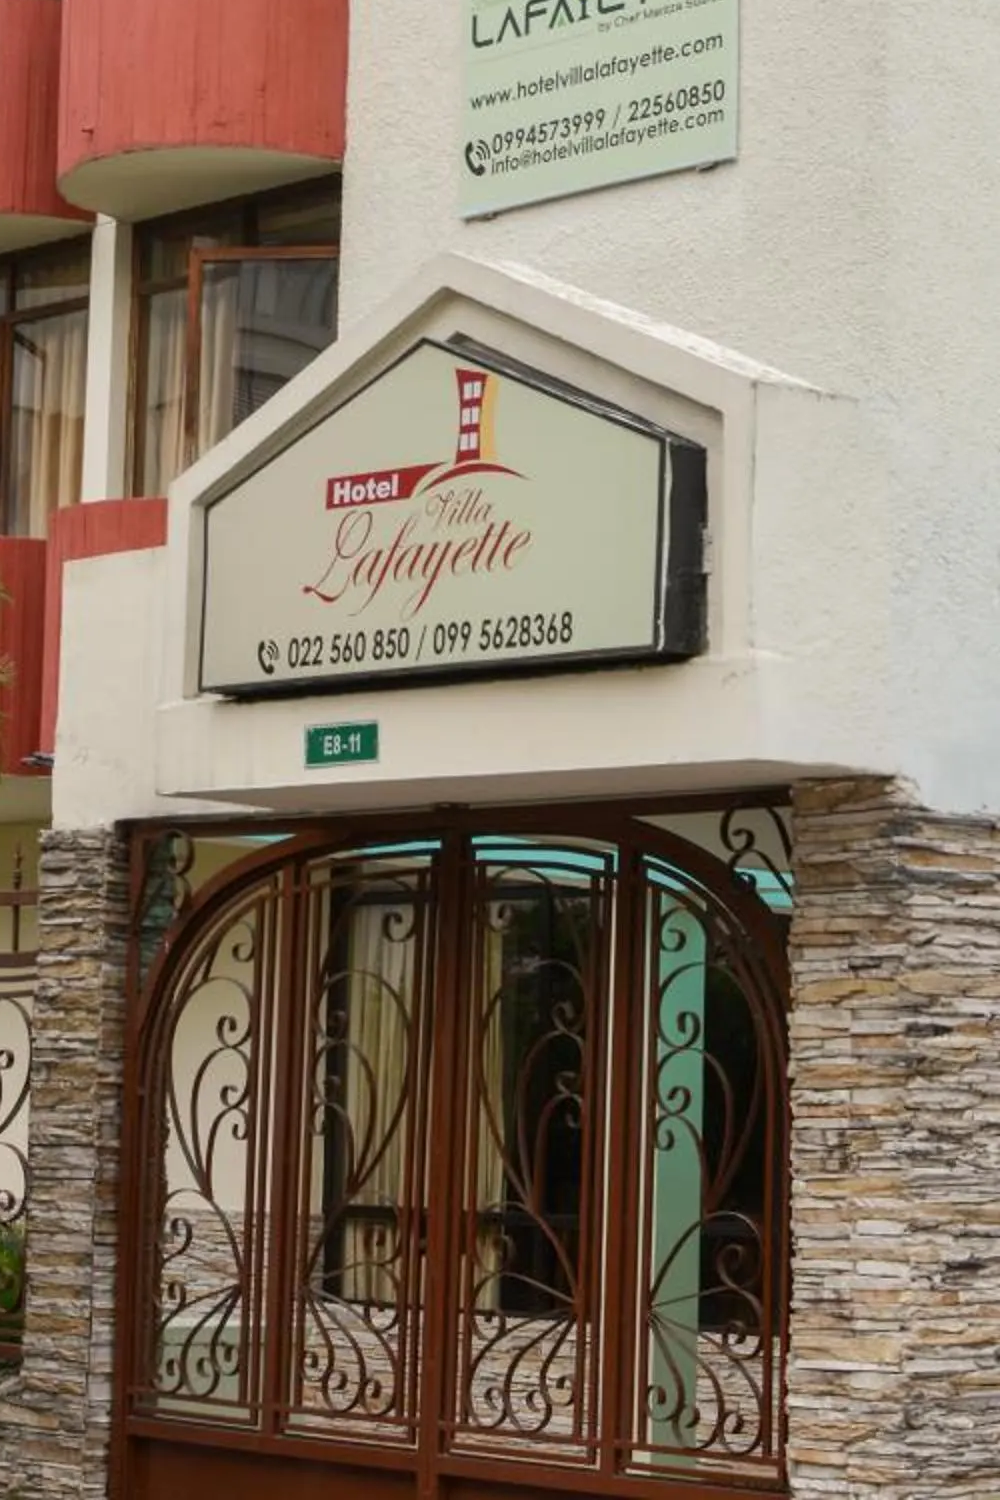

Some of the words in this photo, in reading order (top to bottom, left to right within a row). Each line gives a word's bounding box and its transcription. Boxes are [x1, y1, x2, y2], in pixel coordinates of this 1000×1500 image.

[470, 33, 723, 109] www.hotelvillalafayette.com
[491, 109, 725, 174] info@hotelvillalafayette.com
[492, 109, 606, 155] 0994573999
[627, 80, 725, 123] 22560850
[333, 473, 398, 504] Hotel
[425, 489, 492, 530] Villa
[302, 510, 531, 617] Lafayette
[288, 635, 323, 668] 022
[329, 631, 365, 664] 560
[372, 627, 410, 660] 850
[433, 621, 471, 654] 099
[478, 611, 573, 651] 5628368
[323, 732, 361, 756] E8-11
